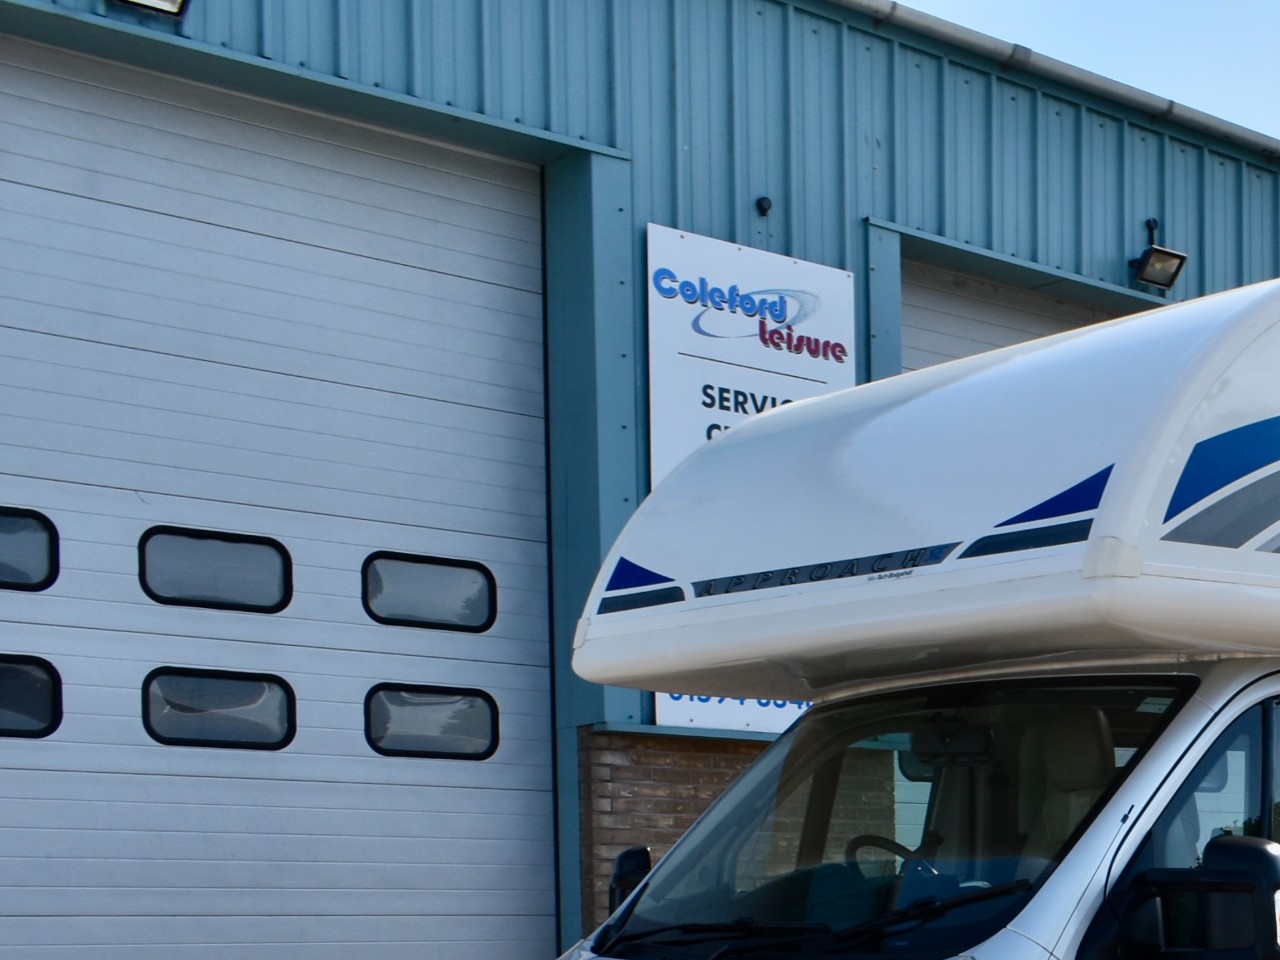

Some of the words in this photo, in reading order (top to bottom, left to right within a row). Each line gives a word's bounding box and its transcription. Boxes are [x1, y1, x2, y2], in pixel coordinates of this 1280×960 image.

[653, 268, 787, 323] Coleford
[701, 384, 794, 415] SERVI
[699, 547, 927, 597] APPROACH
